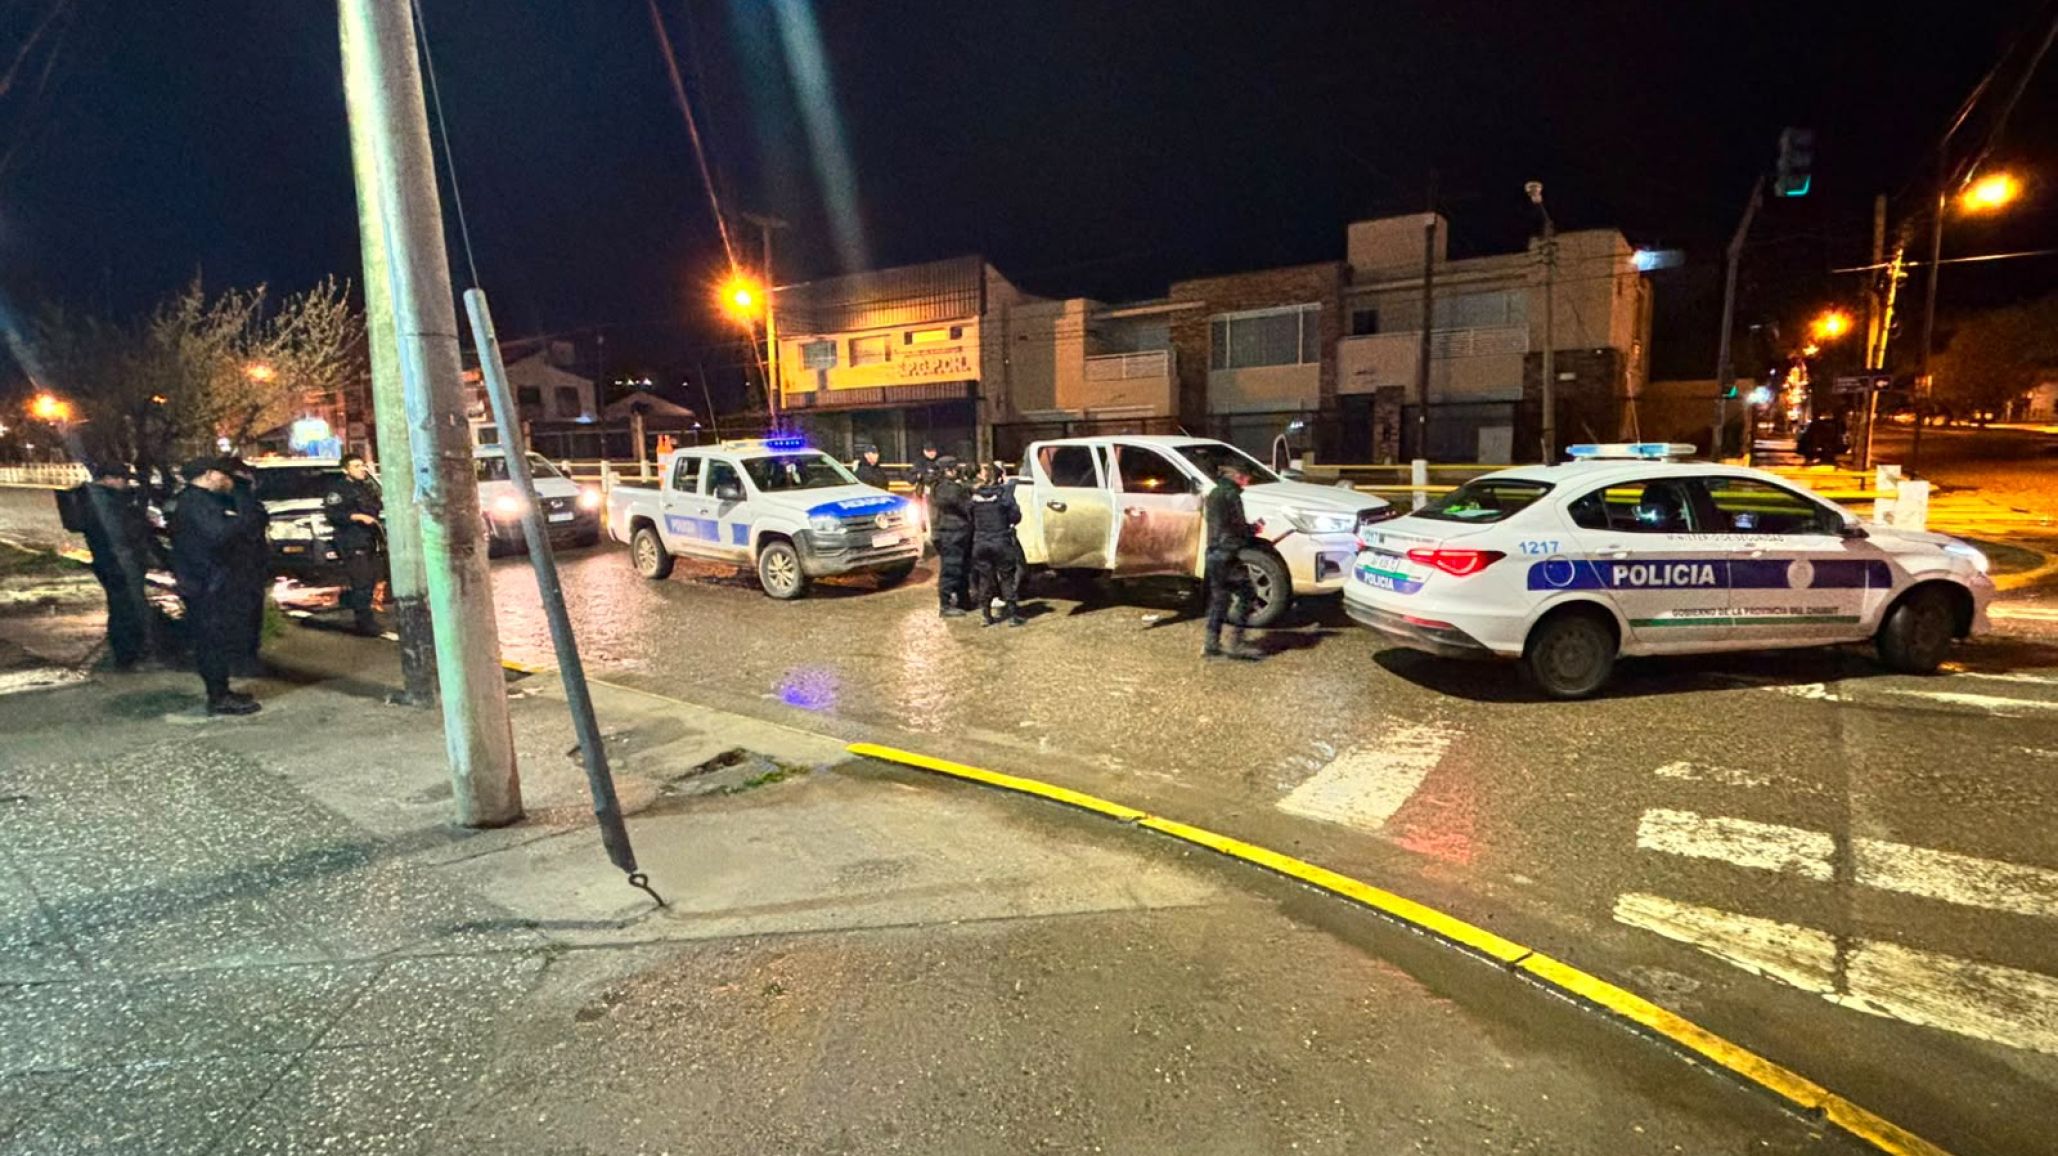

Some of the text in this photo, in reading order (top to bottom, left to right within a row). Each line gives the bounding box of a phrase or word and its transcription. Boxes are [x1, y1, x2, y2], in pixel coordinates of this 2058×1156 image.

[1519, 541, 1559, 555] 1217
[1364, 572, 1394, 591] POLICIA
[1613, 564, 1716, 586] POLICIA
[1672, 608, 1716, 617] GOBIERNO
[1744, 606, 1786, 616] PROVINCIA
